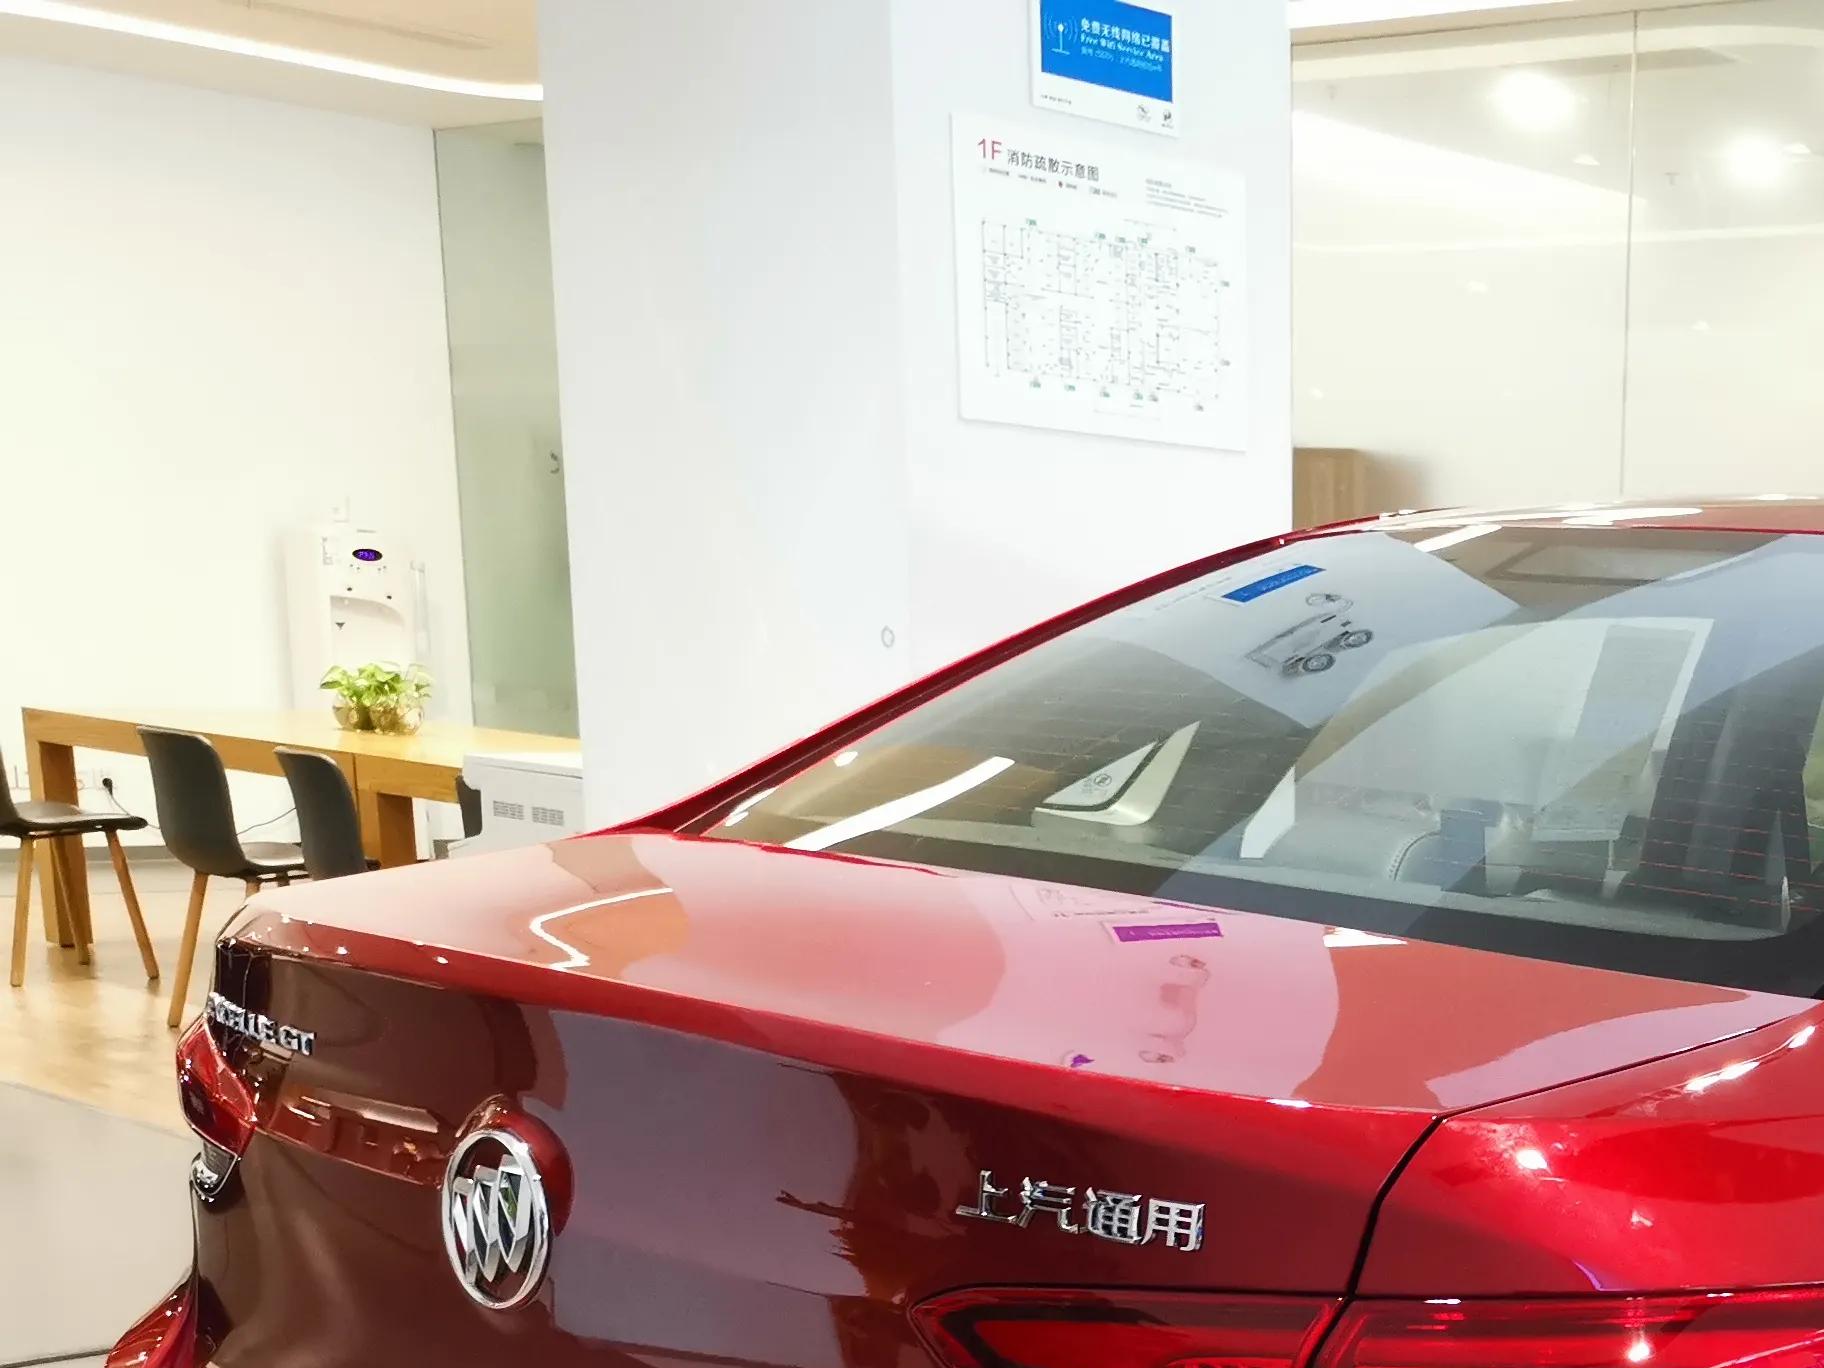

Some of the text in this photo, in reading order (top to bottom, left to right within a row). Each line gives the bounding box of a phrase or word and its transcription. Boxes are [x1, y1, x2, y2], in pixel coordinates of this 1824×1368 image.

[977, 138, 1002, 161] 1F
[1007, 149, 1100, 183] 消防疏散示意图
[279, 1024, 316, 1056] GT
[955, 1169, 1206, 1252] 上汽通用
